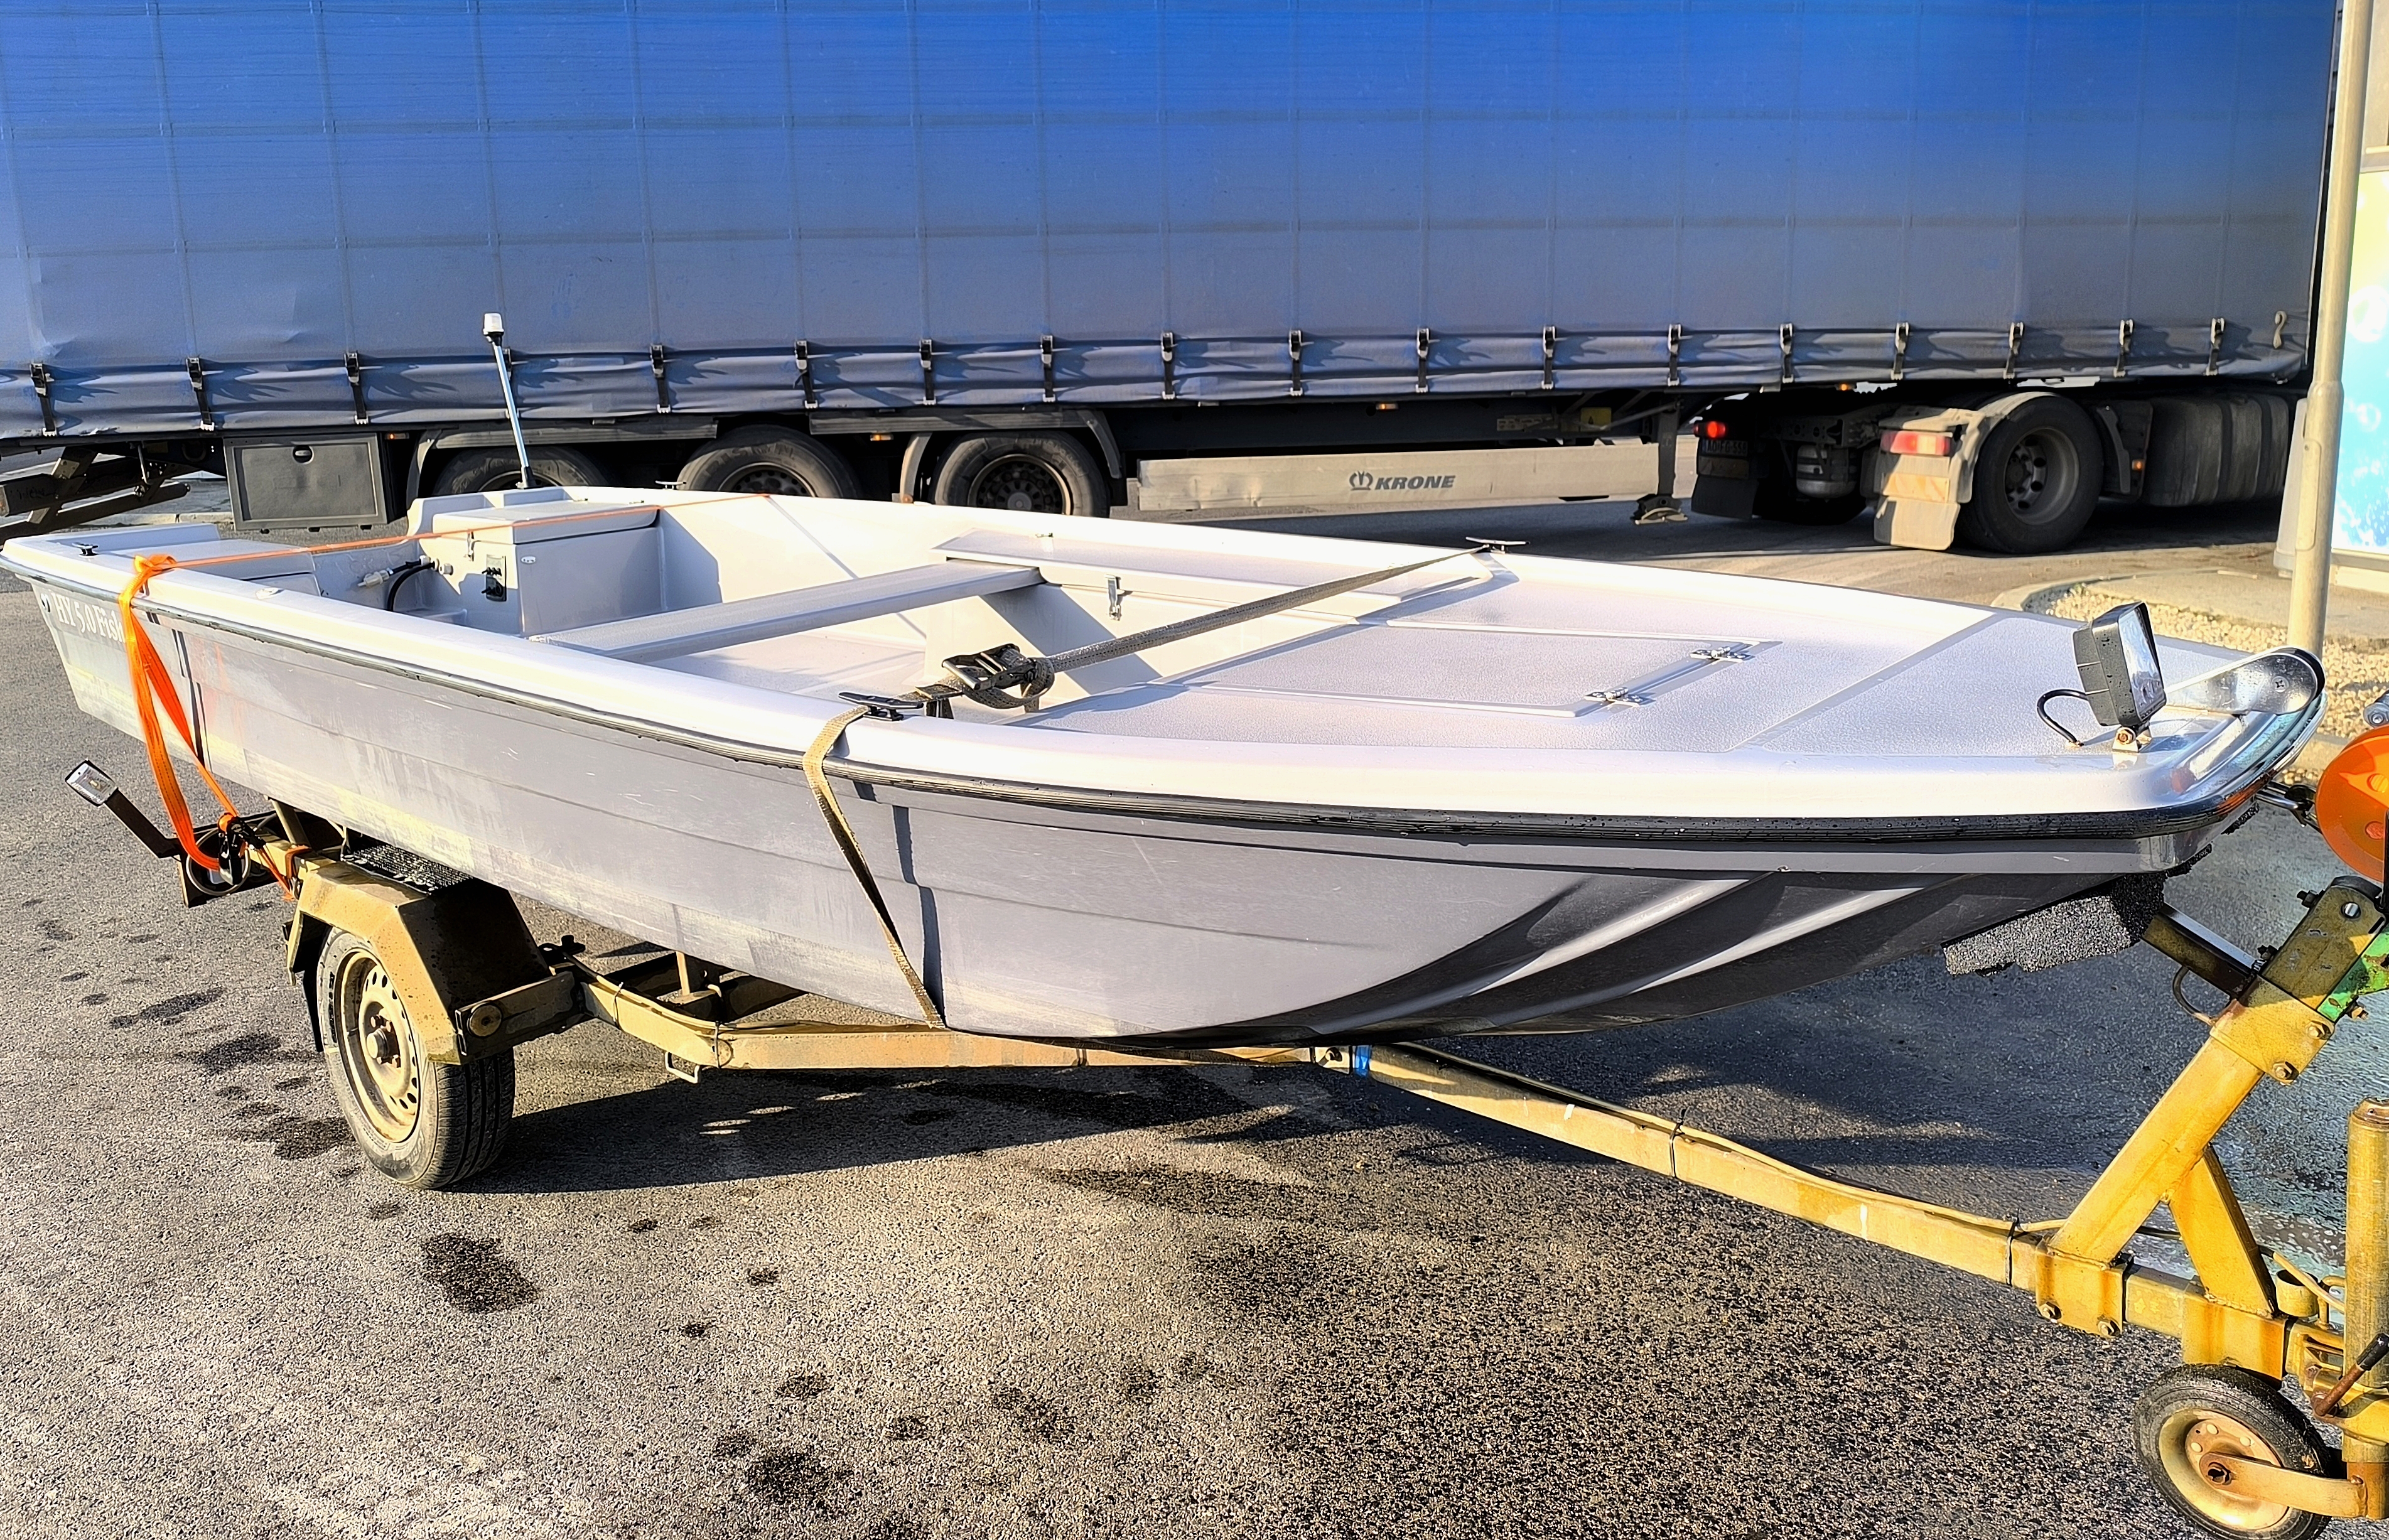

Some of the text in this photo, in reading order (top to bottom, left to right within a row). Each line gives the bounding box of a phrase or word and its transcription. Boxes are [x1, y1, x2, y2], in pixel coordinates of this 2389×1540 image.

[1374, 475, 1456, 490] KRONE
[51, 593, 126, 643] HY 5.0 Fish
